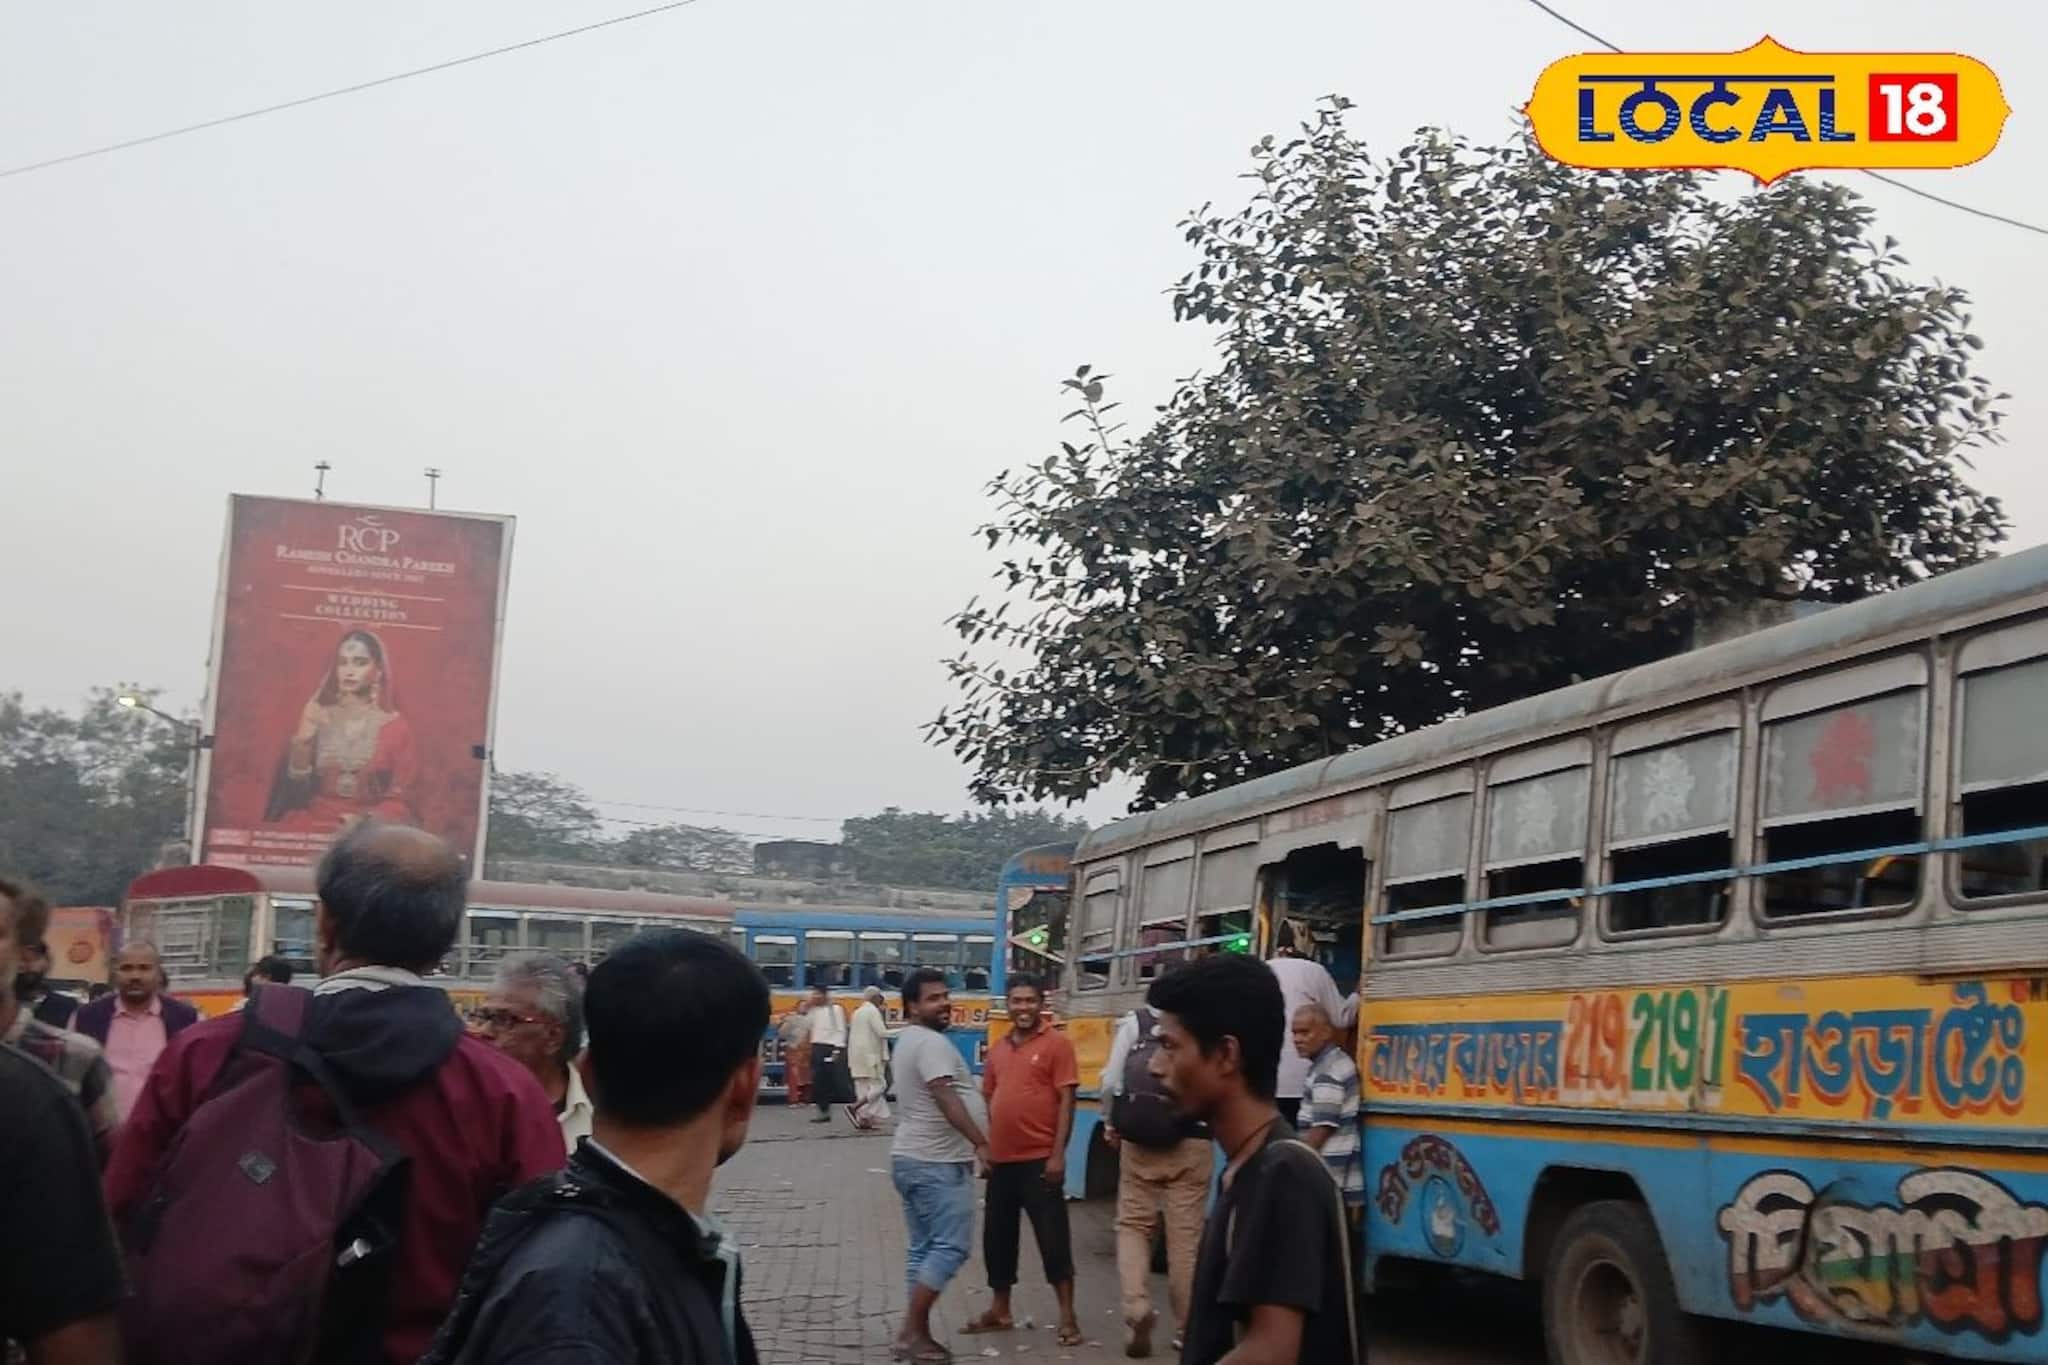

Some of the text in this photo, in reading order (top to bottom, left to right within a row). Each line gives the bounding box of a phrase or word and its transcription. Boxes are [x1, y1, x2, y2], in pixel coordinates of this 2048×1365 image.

[338, 525, 400, 552] RCP
[327, 593, 399, 610] WEDDING
[315, 604, 408, 621] COLLECTION
